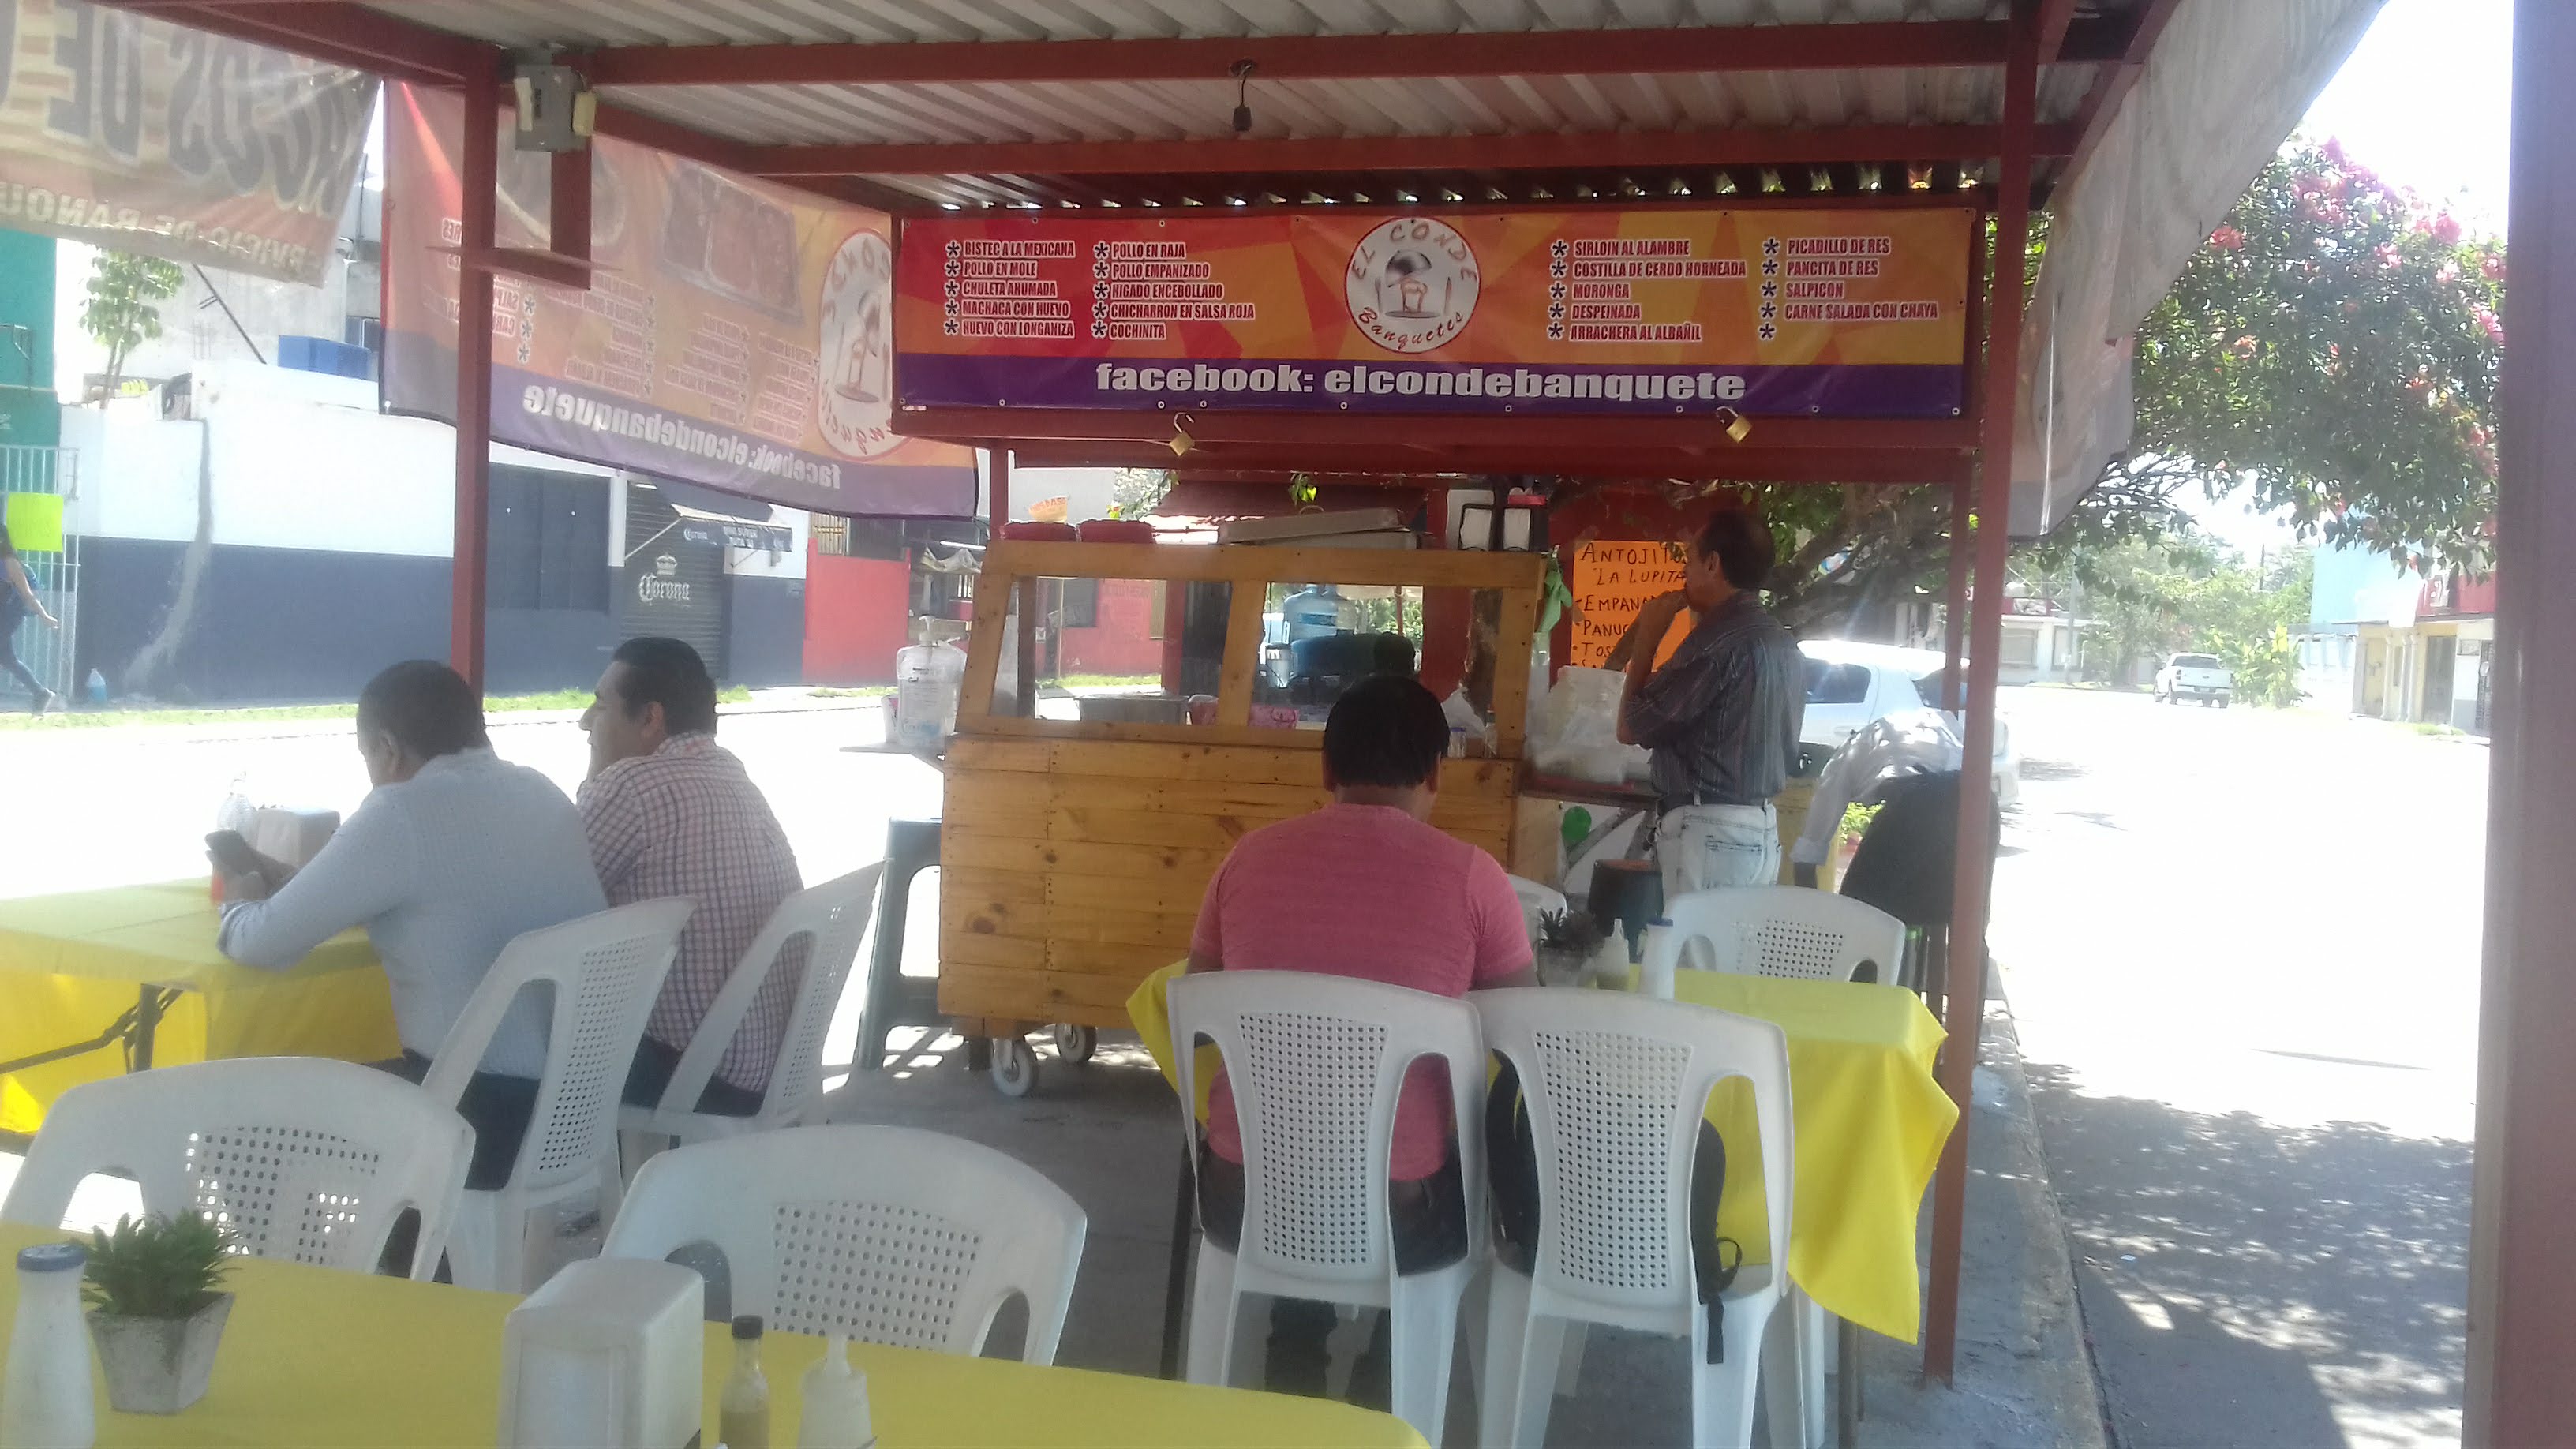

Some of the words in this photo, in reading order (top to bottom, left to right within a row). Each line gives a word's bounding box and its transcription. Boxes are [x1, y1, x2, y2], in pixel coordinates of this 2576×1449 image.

[964, 241, 1001, 256] BISTEC
[1002, 241, 1009, 256] A
[1010, 241, 1023, 256] LA
[1023, 241, 1075, 256] MEXICANA
[1112, 243, 1144, 258] POLLO
[1145, 243, 1159, 258] EN
[1160, 243, 1185, 258] RAJA
[1351, 245, 1375, 280] EL
[1389, 222, 1479, 283] CONDE
[1574, 240, 1619, 256] SIRLOIN
[1621, 240, 1634, 256] AL
[1636, 240, 1690, 256] ALAMBRE
[1787, 238, 1848, 254] PICADILLO
[1849, 238, 1865, 254] DE
[1867, 238, 1890, 254] RES
[964, 261, 994, 276] POLLO
[995, 261, 1008, 276] EN
[1009, 261, 1037, 276] MOLE
[1112, 263, 1143, 279] POLLO
[1144, 263, 1210, 279] EMPANIZADO
[1574, 261, 1627, 277] COSTILLA
[1628, 261, 1642, 277] DE
[1645, 261, 1683, 277] CERDO
[1684, 261, 1747, 276] HORNEADA
[1787, 260, 1837, 276] PANCITA
[1838, 260, 1854, 276] DE
[1855, 260, 1879, 276] RES
[963, 281, 1006, 297] CHULETA
[1006, 281, 1057, 297] AHUMADA
[1112, 283, 1151, 298] HIGADO
[1152, 283, 1223, 298] ENCEBOLLADO
[1573, 283, 1630, 299] MORONGA
[1785, 282, 1844, 298] SALPICON
[962, 301, 1012, 316] MACHACA
[1013, 301, 1035, 316] CON
[1035, 301, 1070, 316] HUEVO
[1110, 303, 1178, 319] CHICHARRON
[1179, 303, 1193, 319] EN
[1194, 303, 1228, 319] SALSA
[1228, 303, 1255, 319] ROJA
[1571, 304, 1641, 320] DESPEINADA
[1784, 304, 1823, 320] CARNE
[1825, 304, 1870, 320] SALADA
[1872, 303, 1897, 319] CON
[1900, 302, 1938, 319] CHAYA
[962, 320, 994, 335] HUEVO
[996, 320, 1018, 335] CON
[1018, 321, 1074, 337] LONGANIZA
[1110, 324, 1165, 339] COCHINITA
[1570, 324, 1638, 341] ARRACHERA
[1638, 324, 1653, 341] AL
[1654, 321, 1702, 340] ALBAÑIL
[1095, 363, 1314, 392] facebook:
[1324, 365, 1746, 401] elcondebanquete
[639, 572, 690, 606] Corona
